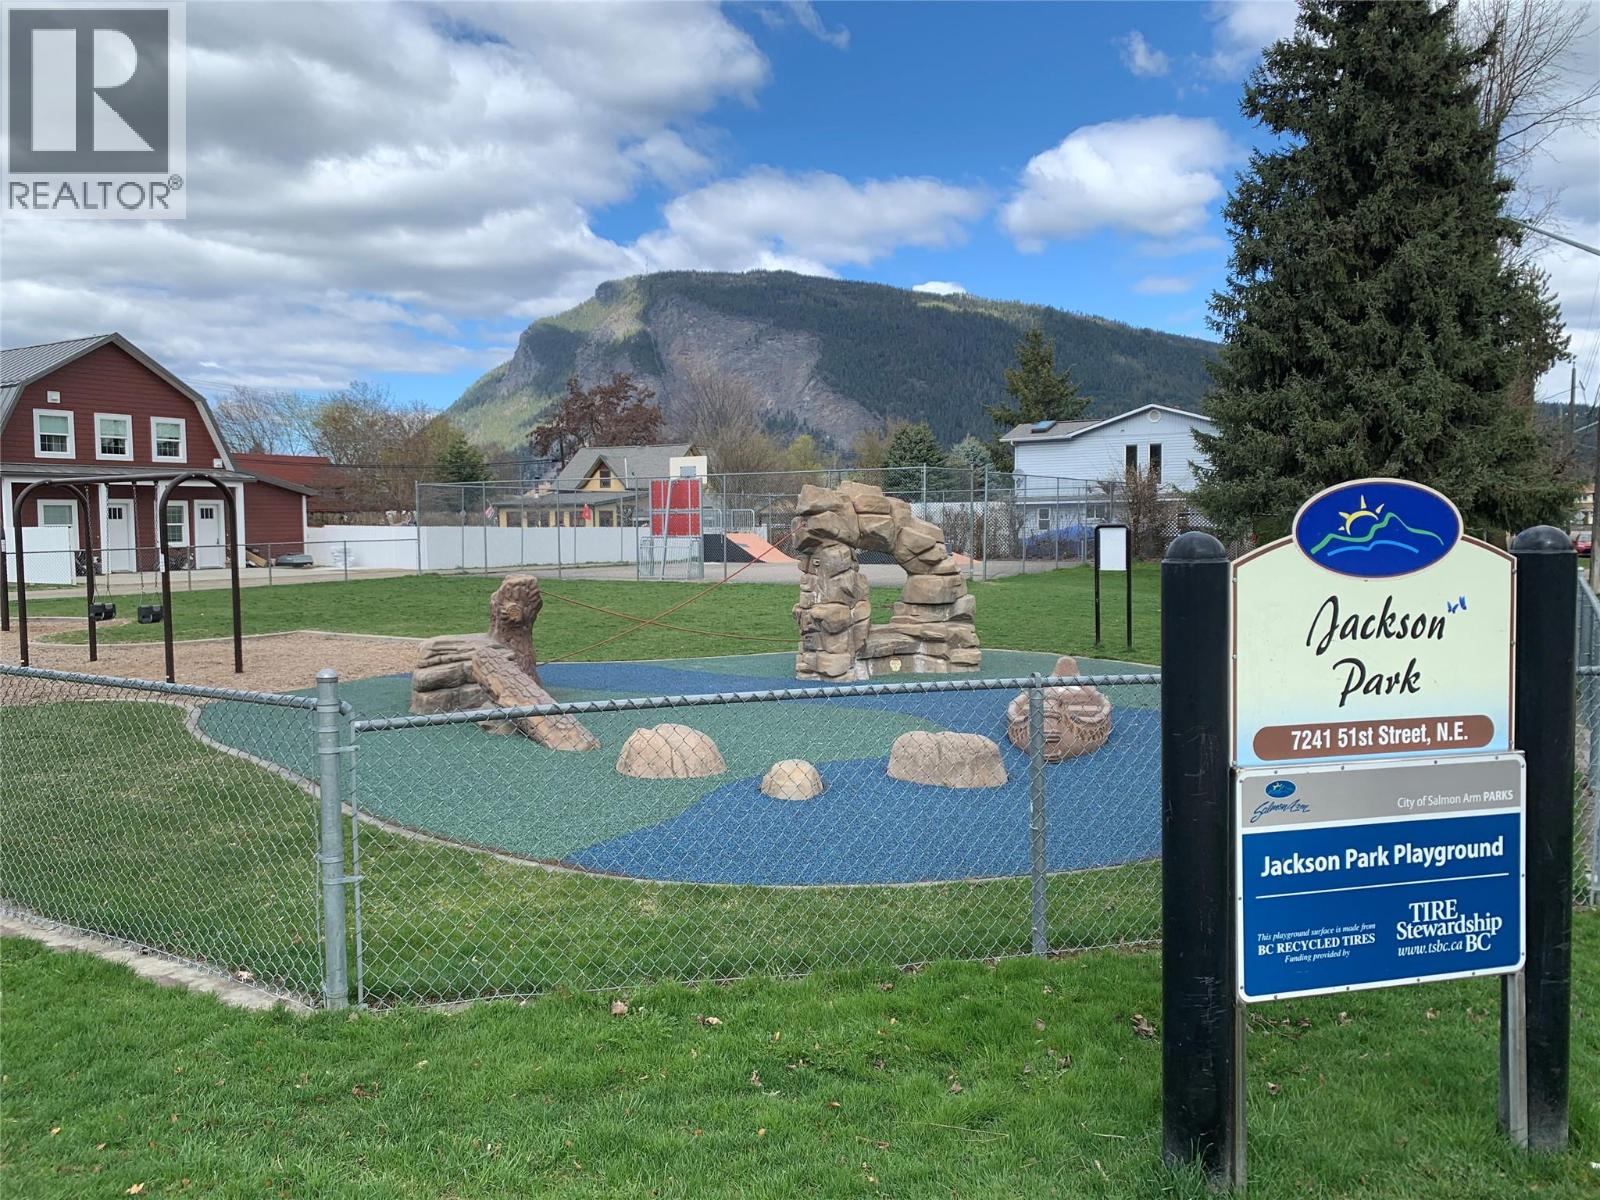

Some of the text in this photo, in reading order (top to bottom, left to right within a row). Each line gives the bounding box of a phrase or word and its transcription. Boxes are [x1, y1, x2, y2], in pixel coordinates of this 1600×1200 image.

[1305, 595, 1446, 656] Jackson
[1332, 657, 1421, 708] Park
[1291, 721, 1468, 751] 7241 51st Street, N.E.
[1397, 790, 1514, 810] City of Salmon Arm PARKS
[1260, 835, 1504, 877] Jackson Park Playground
[1408, 899, 1459, 923] TIRE
[1257, 922, 1376, 942] This playground surface is made from
[1396, 912, 1503, 940] Stewardship
[1258, 932, 1376, 956] BC RECYCLED TIRES
[1398, 939, 1463, 957] www.tsbc.ca
[1465, 932, 1492, 953] BC
[1284, 948, 1350, 963] Funding provided by
